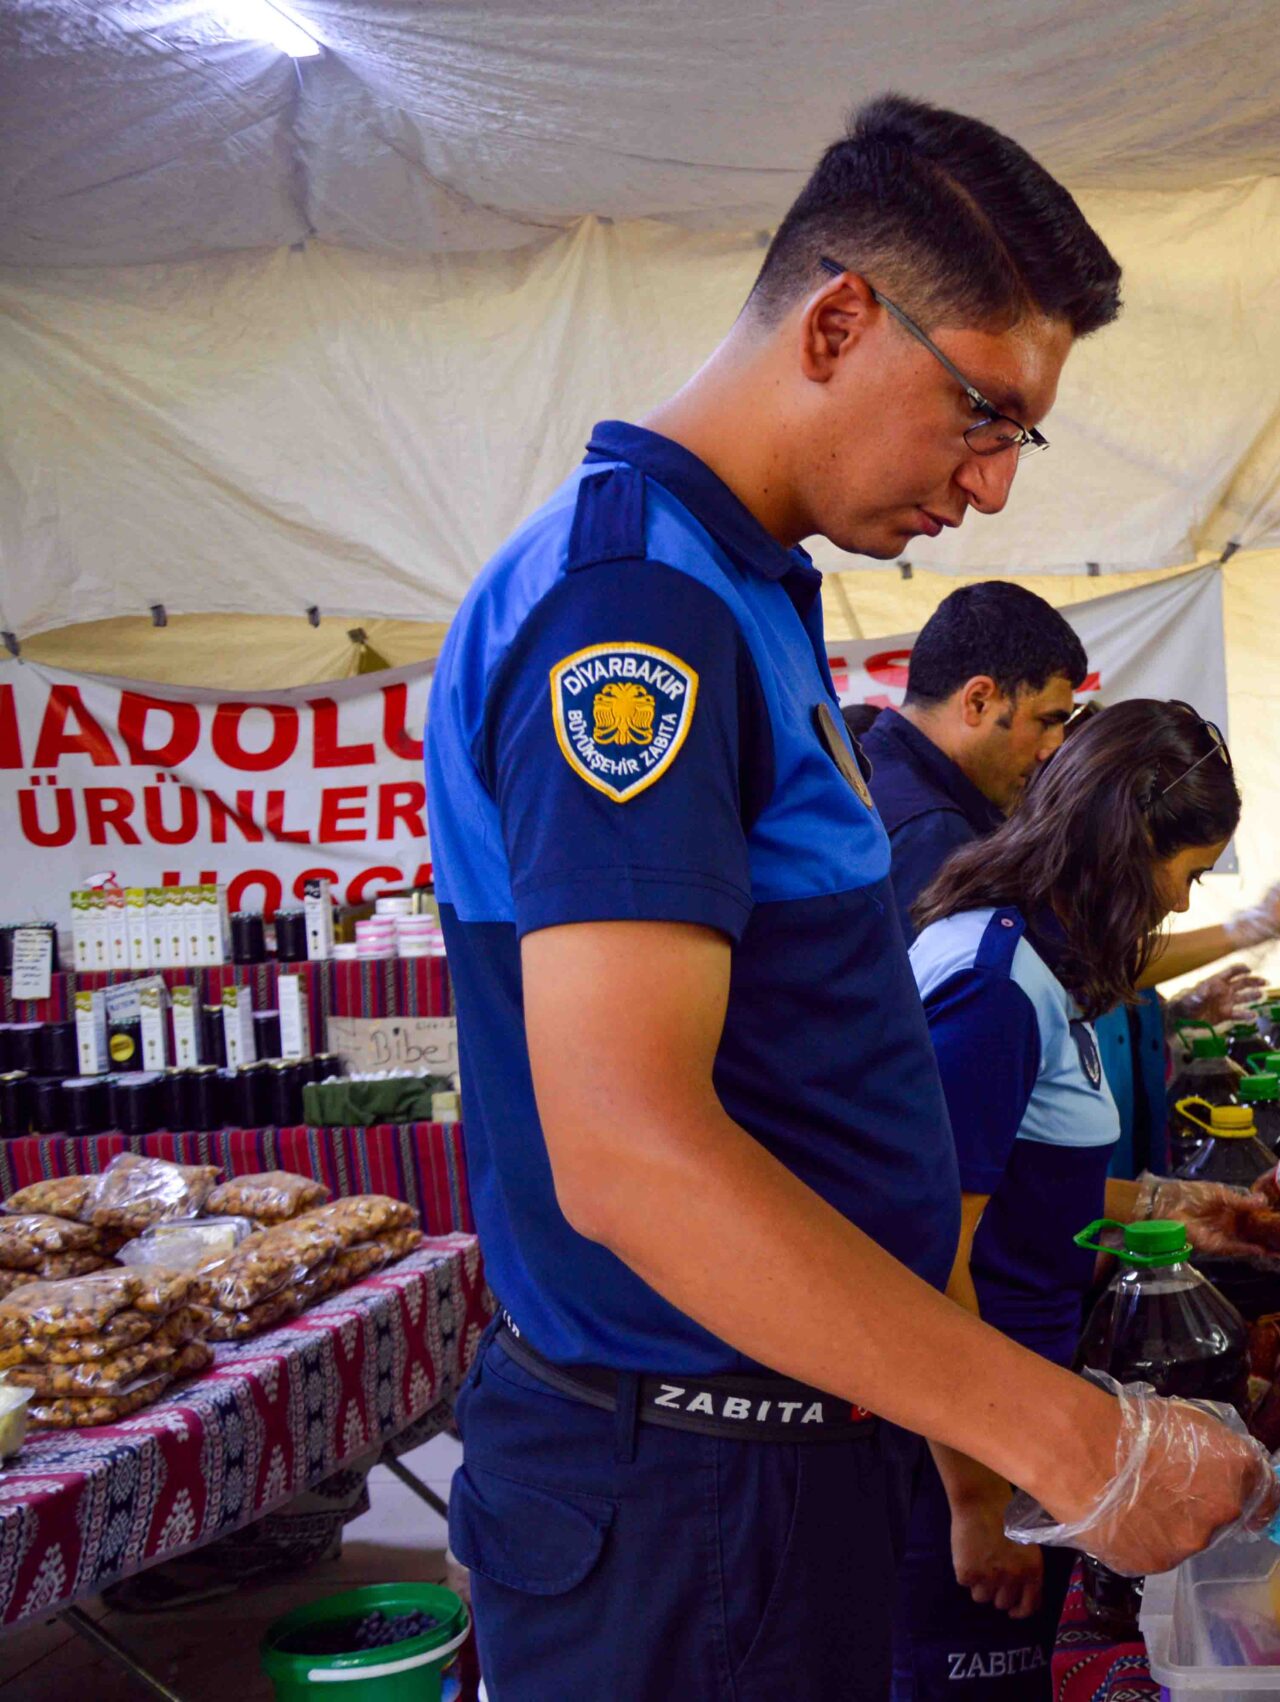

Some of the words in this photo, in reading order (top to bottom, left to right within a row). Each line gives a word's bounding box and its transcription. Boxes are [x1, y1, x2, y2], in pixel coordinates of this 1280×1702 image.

[563, 656, 686, 700] DİYARBAKIR
[0, 683, 425, 772] ADOLU
[567, 709, 641, 776] BÜYÜKŞEHİR
[639, 712, 678, 768] ZABITA
[654, 1383, 824, 1424] ZABITA
[947, 1647, 1047, 1681] ZABITA
